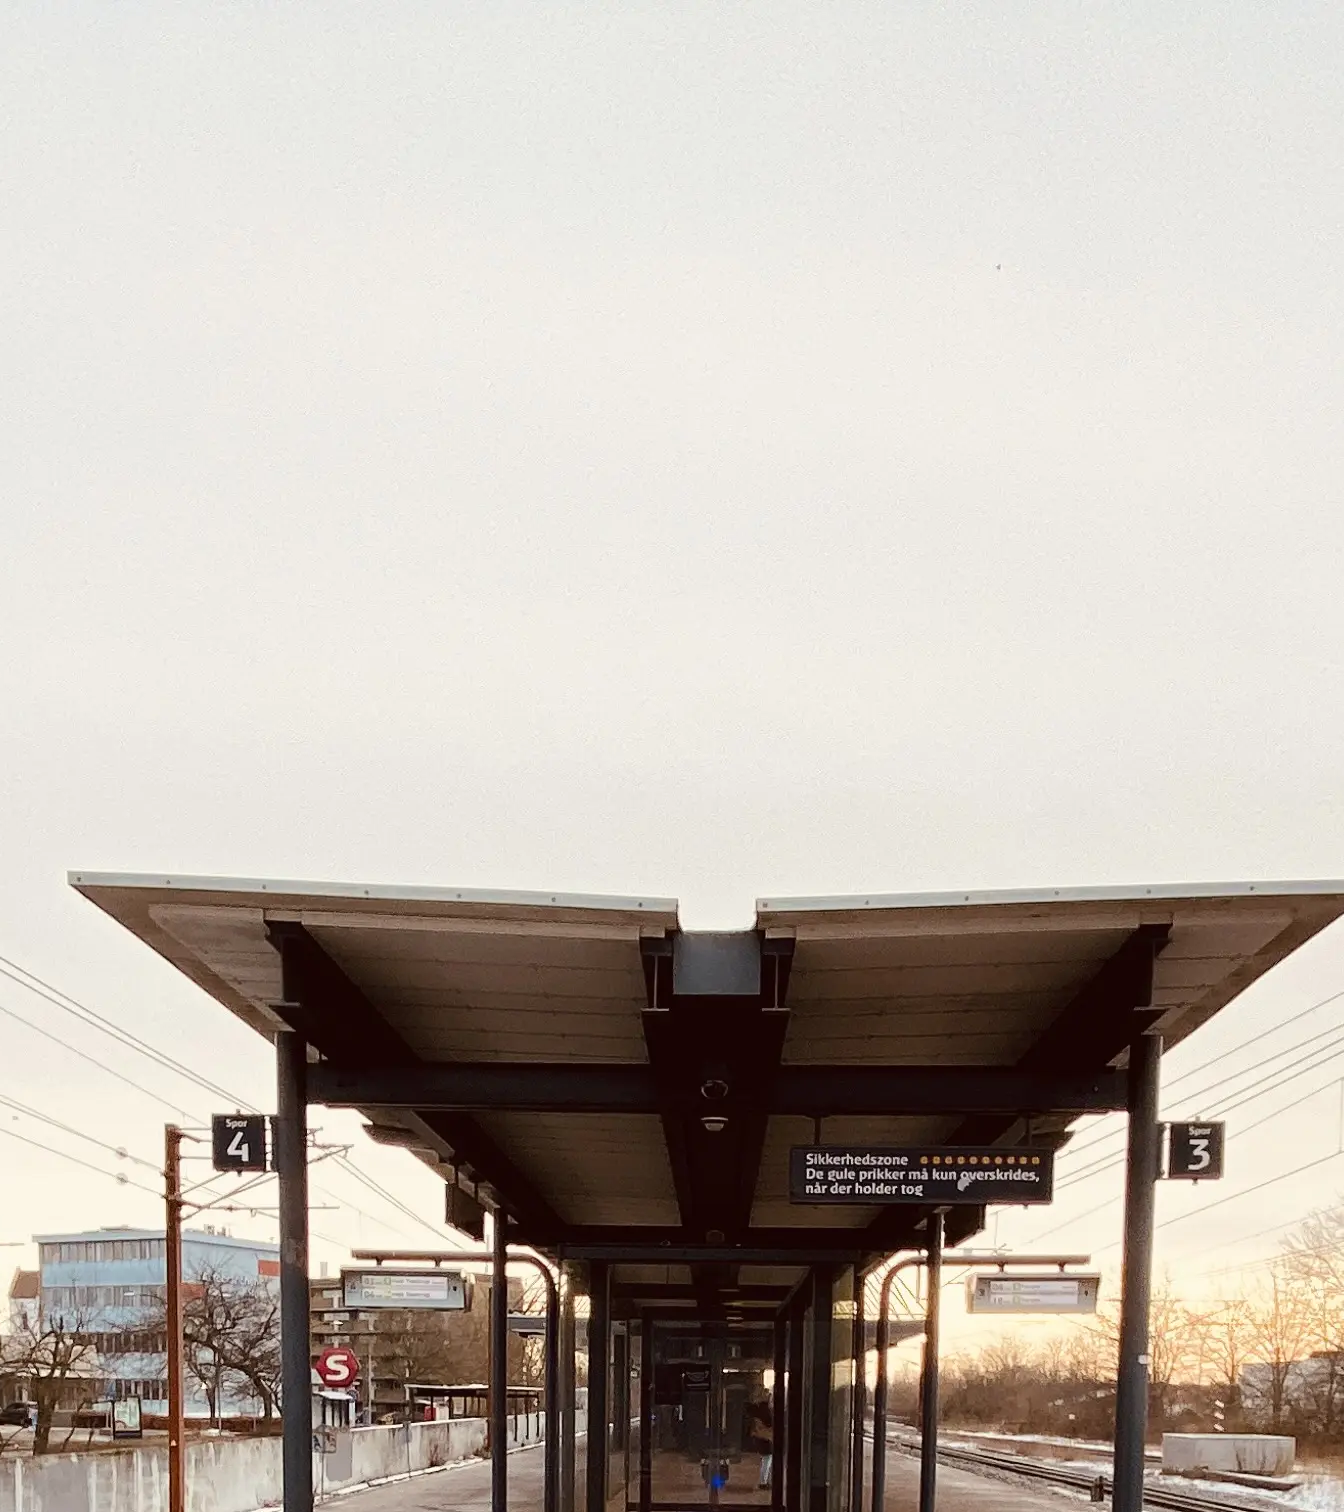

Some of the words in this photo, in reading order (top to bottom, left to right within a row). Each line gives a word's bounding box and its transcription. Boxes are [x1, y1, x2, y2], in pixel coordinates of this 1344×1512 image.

[225, 1118, 248, 1130] Spor
[226, 1131, 249, 1162] 4
[1187, 1138, 1211, 1171] 3
[805, 1153, 909, 1166] Sikkerhedszone
[805, 1167, 824, 1180] De
[827, 1167, 856, 1182] gule
[858, 1167, 906, 1183] prikker
[908, 1167, 929, 1180] må
[932, 1168, 957, 1180] kun
[959, 1168, 1040, 1183] overskrides,
[805, 1181, 828, 1194] når
[829, 1182, 853, 1195] der
[855, 1182, 898, 1195] holder
[900, 1183, 924, 1197] tog
[325, 1354, 350, 1381] S
